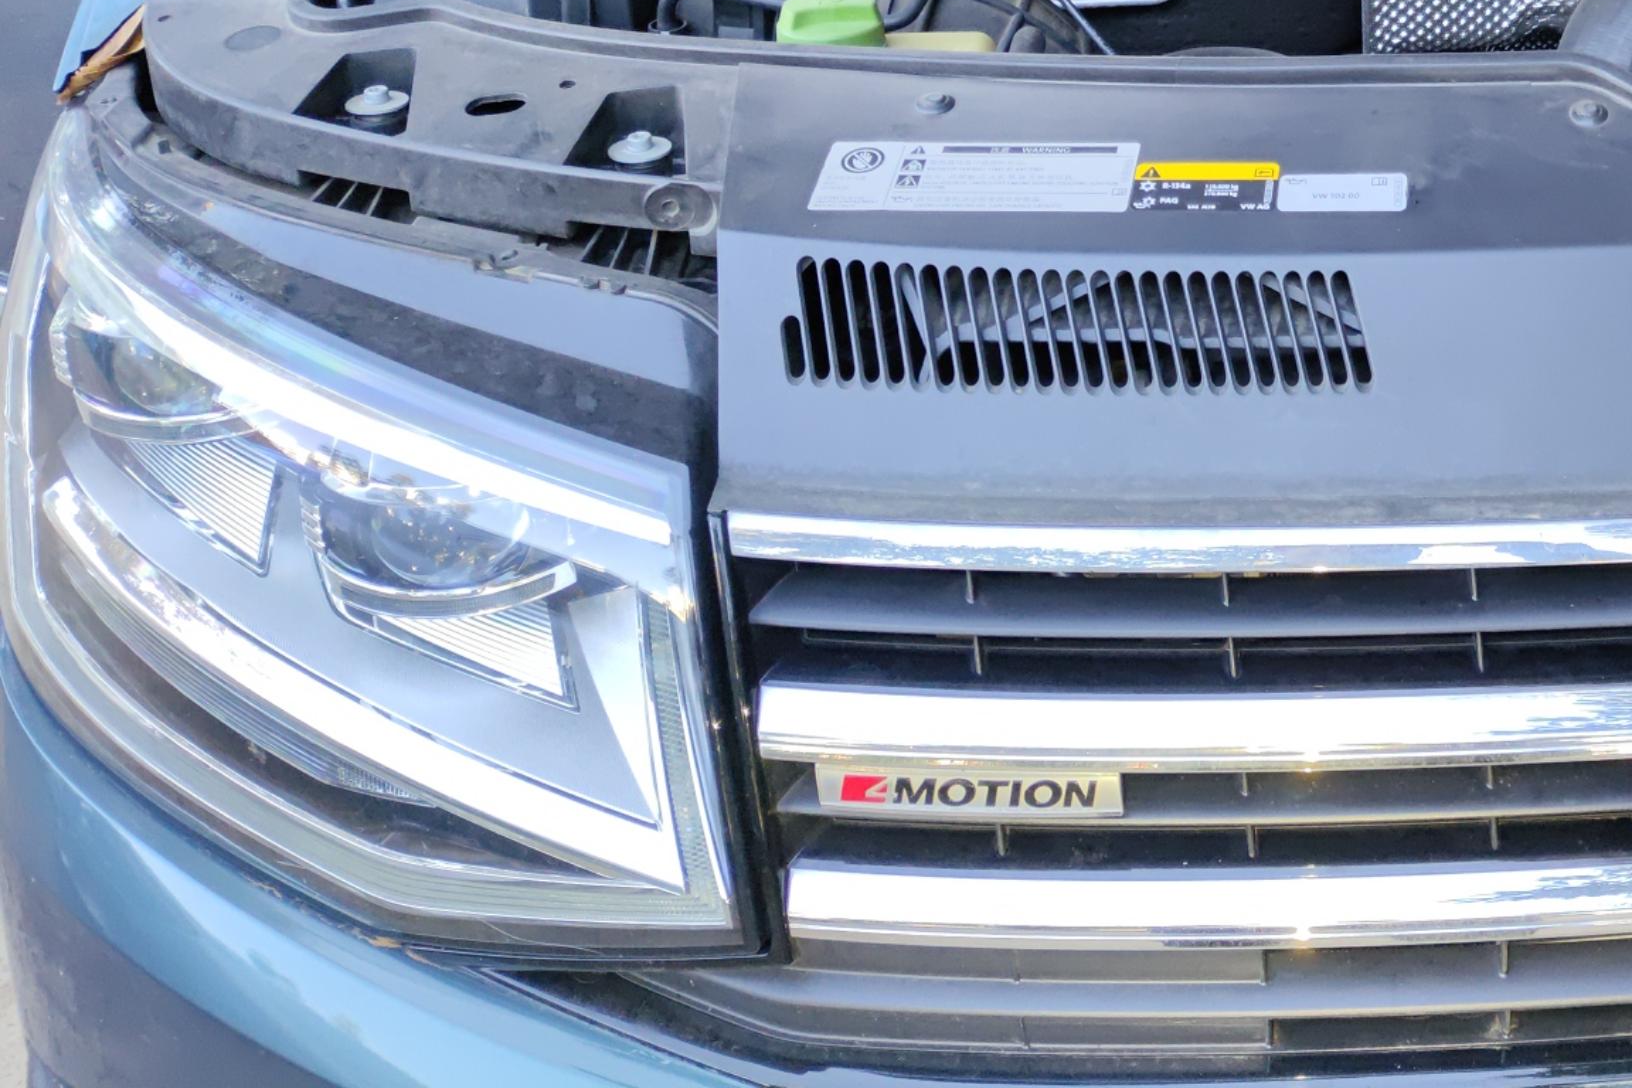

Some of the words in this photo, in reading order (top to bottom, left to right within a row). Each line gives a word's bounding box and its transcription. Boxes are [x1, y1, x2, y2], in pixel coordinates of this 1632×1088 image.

[1022, 146, 1071, 154] WARNING
[1162, 182, 1191, 190] R-134a
[1312, 191, 1329, 200] VW
[1160, 197, 1179, 205] PAG
[1240, 203, 1256, 211] VW
[841, 774, 1098, 808] 4MOTION
